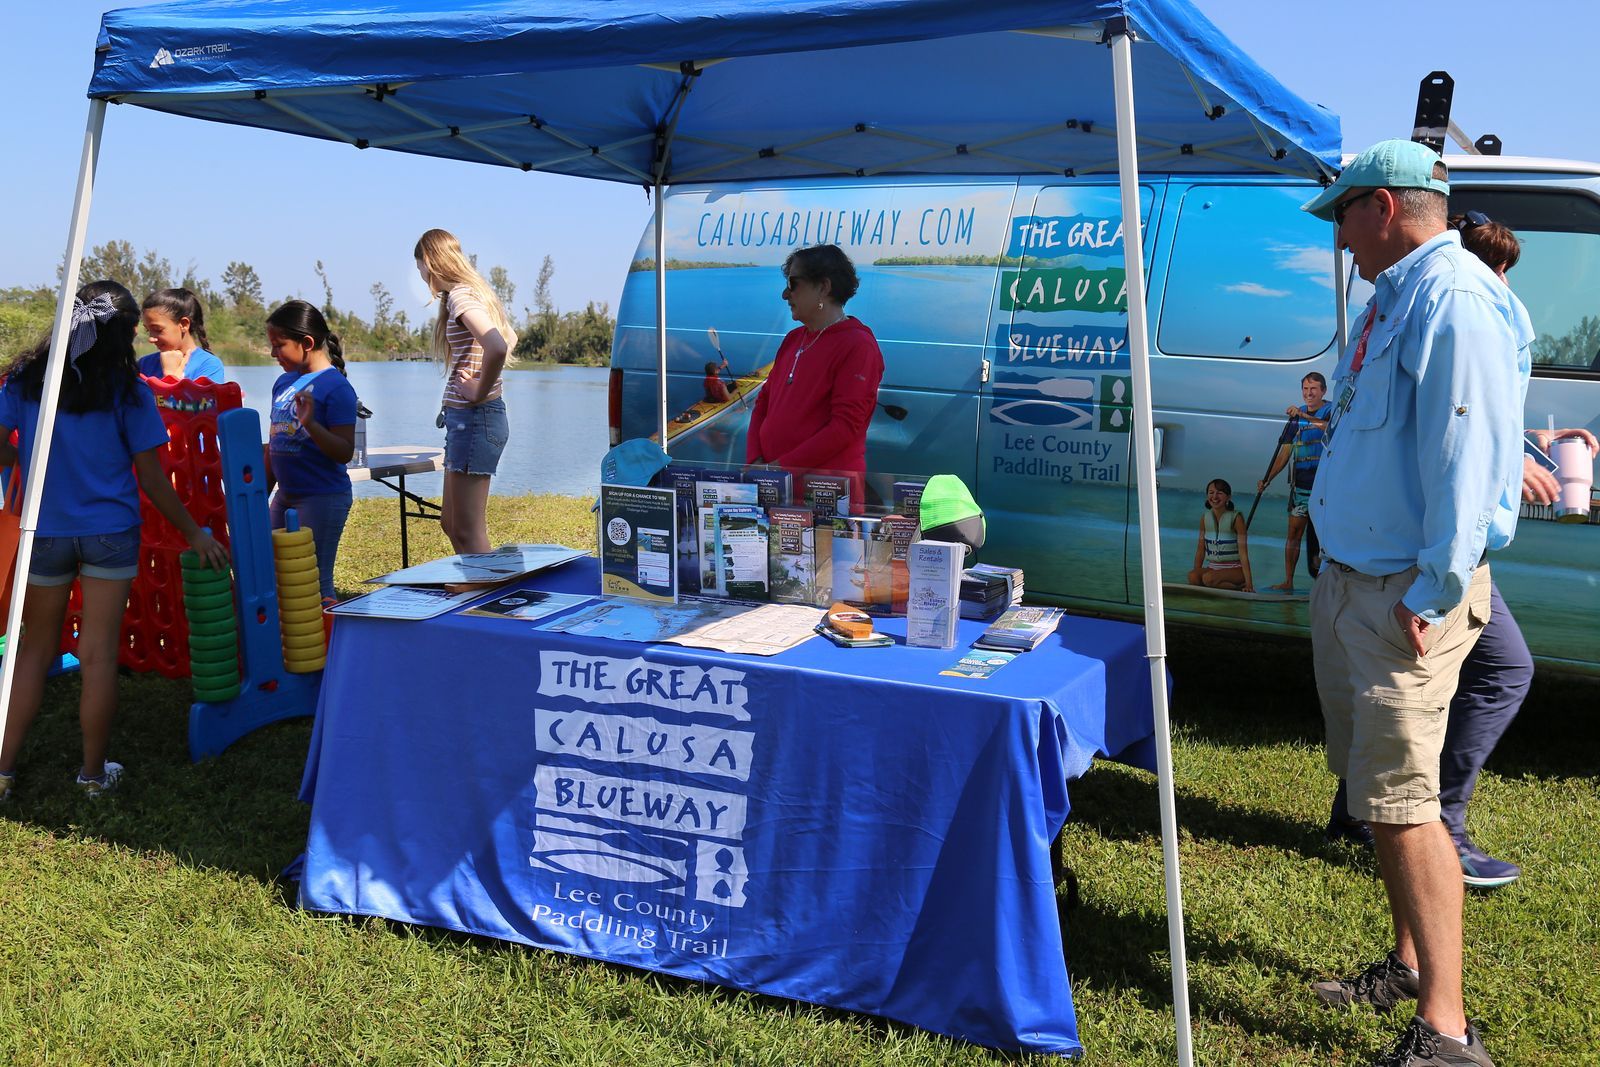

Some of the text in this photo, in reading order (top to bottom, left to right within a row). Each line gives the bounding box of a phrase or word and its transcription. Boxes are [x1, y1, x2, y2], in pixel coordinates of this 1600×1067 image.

[174, 43, 232, 58] OZARK TRAIL
[697, 207, 976, 247] CALUSABLUEWAY.COM
[1019, 219, 1145, 249] THE GREA
[1008, 332, 1124, 364] BLUEWAY
[1004, 433, 1112, 462] Lee County
[993, 455, 1120, 484] Paddling Trail
[918, 554, 944, 563] Rentals
[919, 547, 936, 555] Sales
[551, 660, 742, 705] THE GREAT
[549, 718, 737, 770] CALUSA
[554, 777, 728, 829] BLUEWAY
[554, 881, 715, 934] Lee County
[531, 904, 728, 958] Paddling Trail
